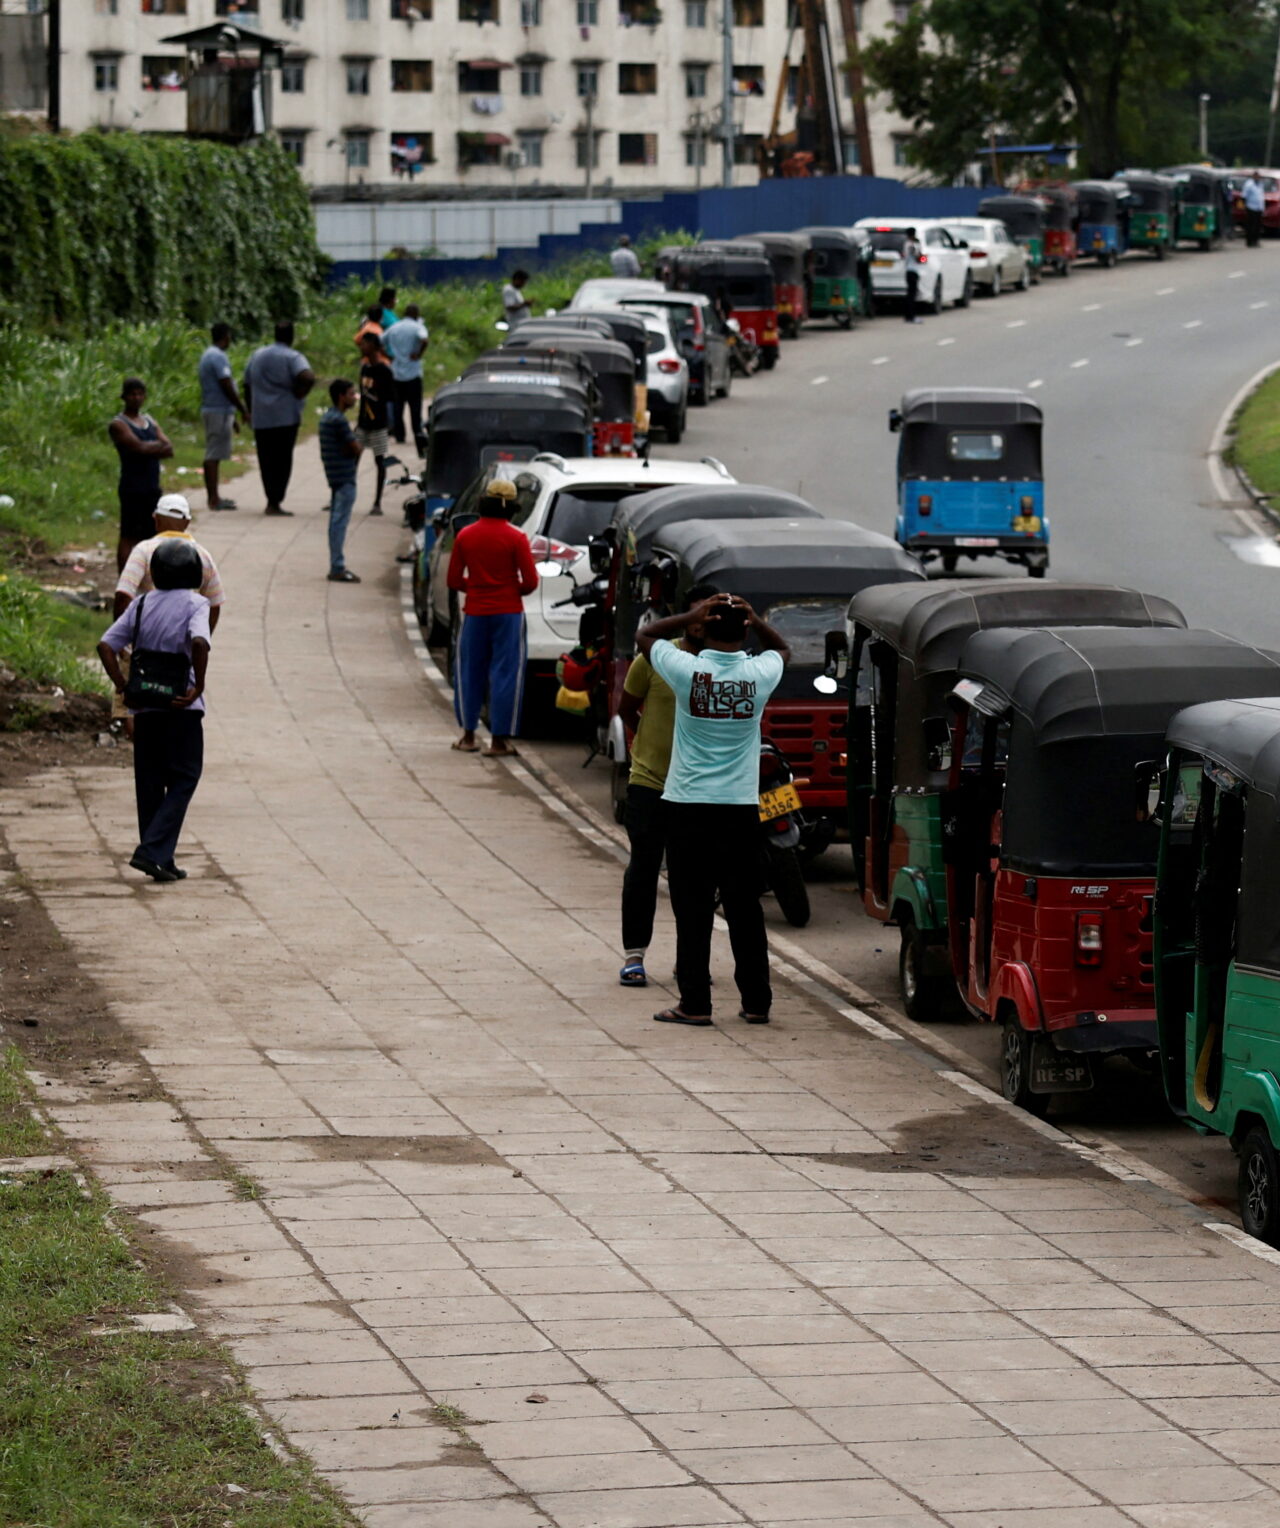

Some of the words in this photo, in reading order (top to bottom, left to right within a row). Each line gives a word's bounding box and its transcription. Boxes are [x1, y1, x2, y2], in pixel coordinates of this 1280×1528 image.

[1070, 886, 1086, 894] RE
[1087, 886, 1109, 894] SP
[1036, 1067, 1085, 1083] RE-SP
